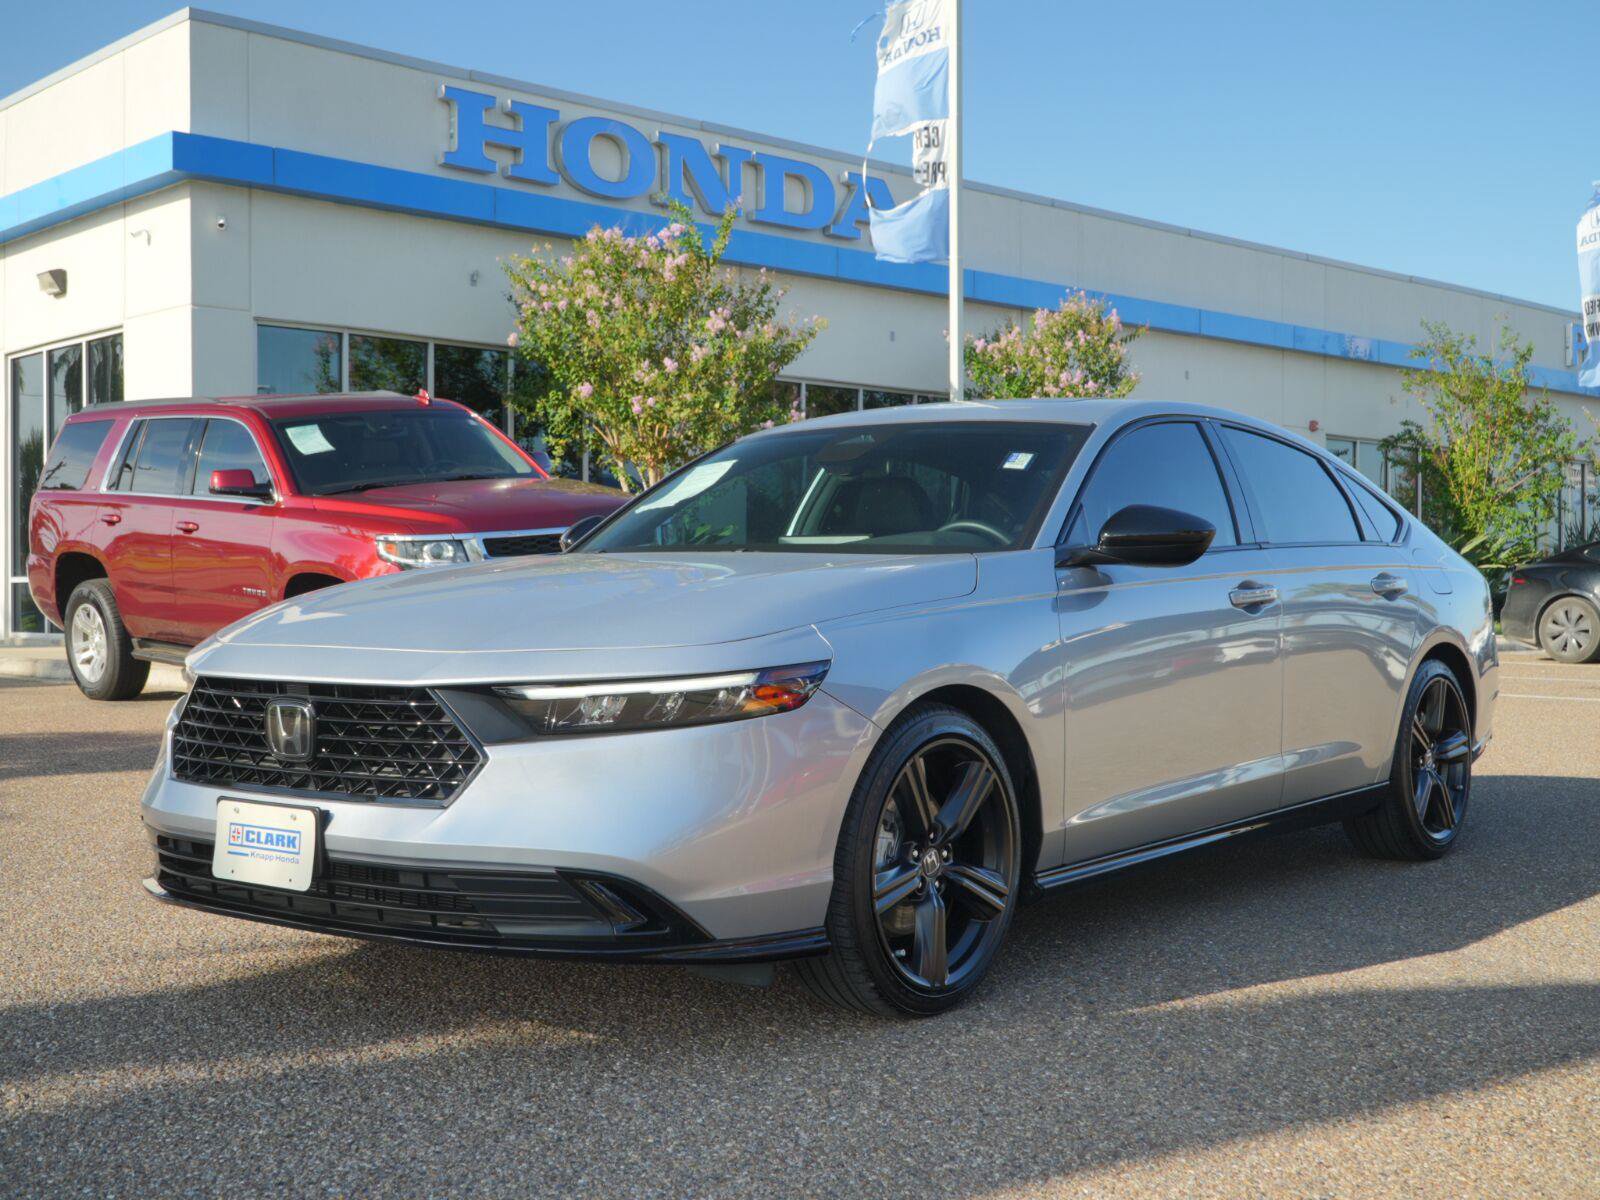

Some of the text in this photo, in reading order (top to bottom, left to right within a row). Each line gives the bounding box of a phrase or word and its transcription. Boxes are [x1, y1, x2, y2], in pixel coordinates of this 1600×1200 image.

[438, 83, 897, 240] HONDA
[245, 829, 297, 849] CLARK
[250, 851, 300, 865] Knapp Honda
